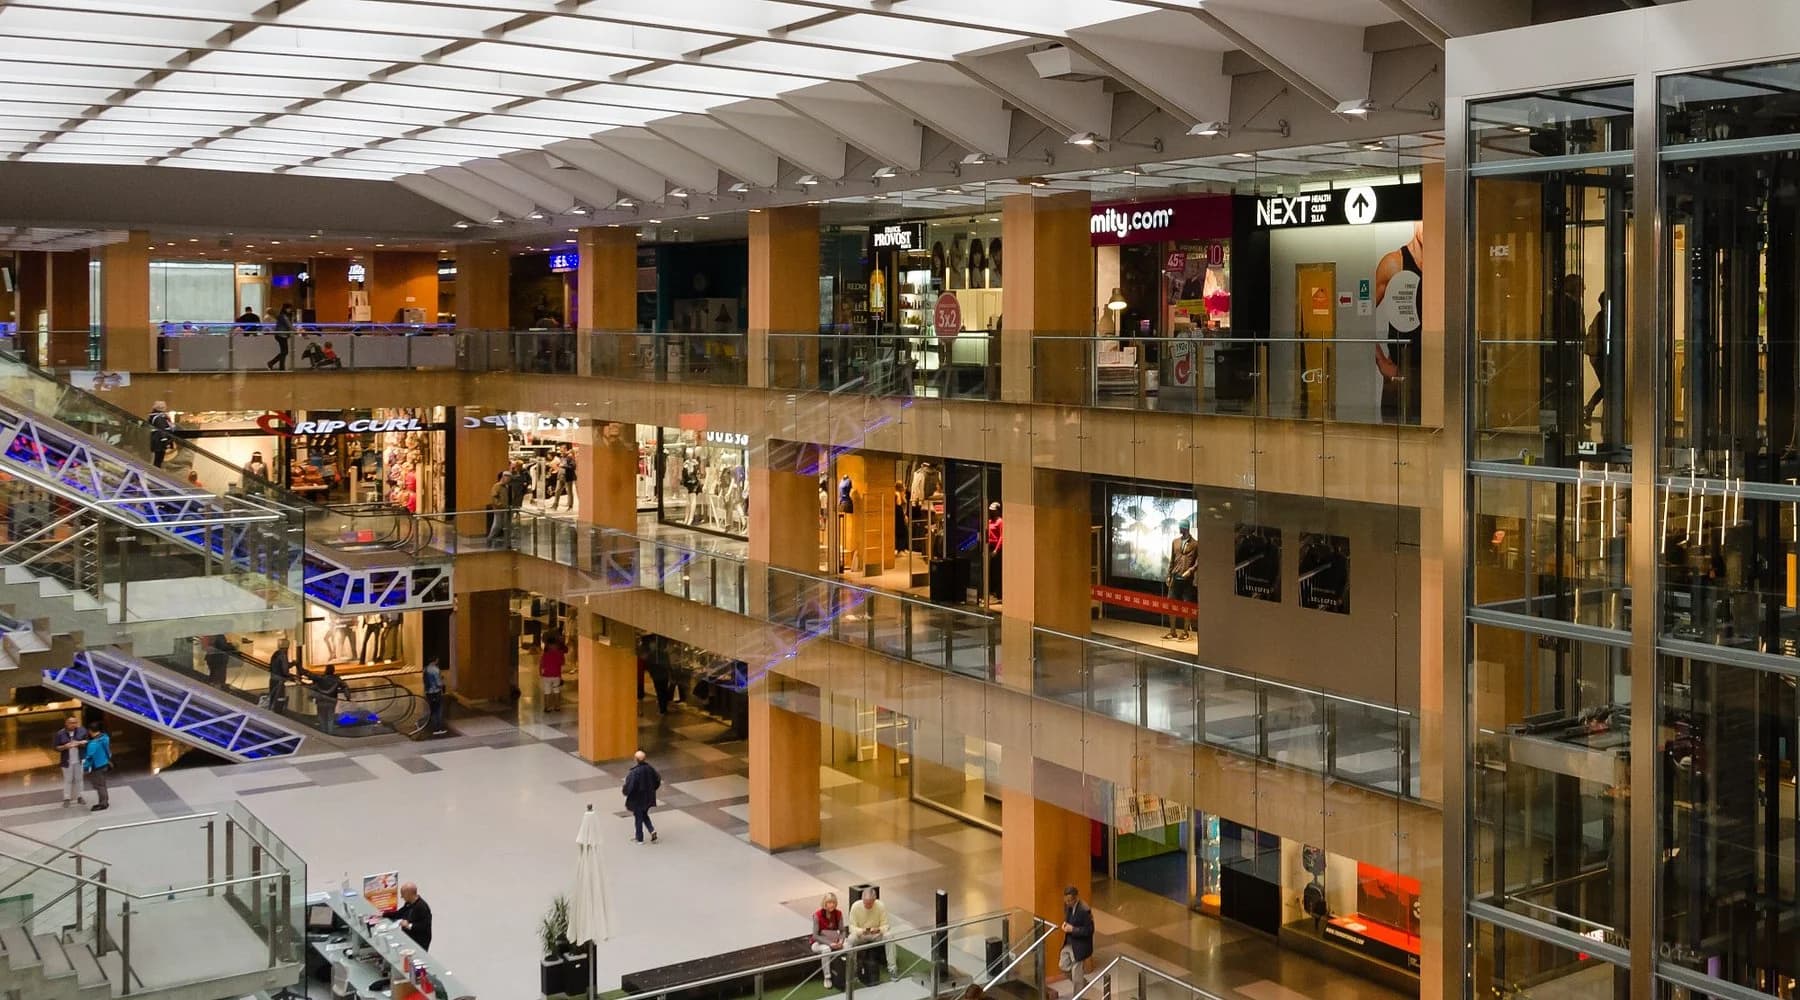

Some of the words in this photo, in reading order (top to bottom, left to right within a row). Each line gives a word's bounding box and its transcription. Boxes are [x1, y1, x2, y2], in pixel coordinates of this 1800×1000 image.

[1311, 194, 1332, 203] HEALTH
[1257, 195, 1311, 226] NEXT
[1311, 204, 1327, 213] CLUB
[874, 231, 912, 247] PROVOST
[938, 309, 957, 328] 3x2
[294, 420, 347, 435] RIP
[348, 418, 423, 433] CURL
